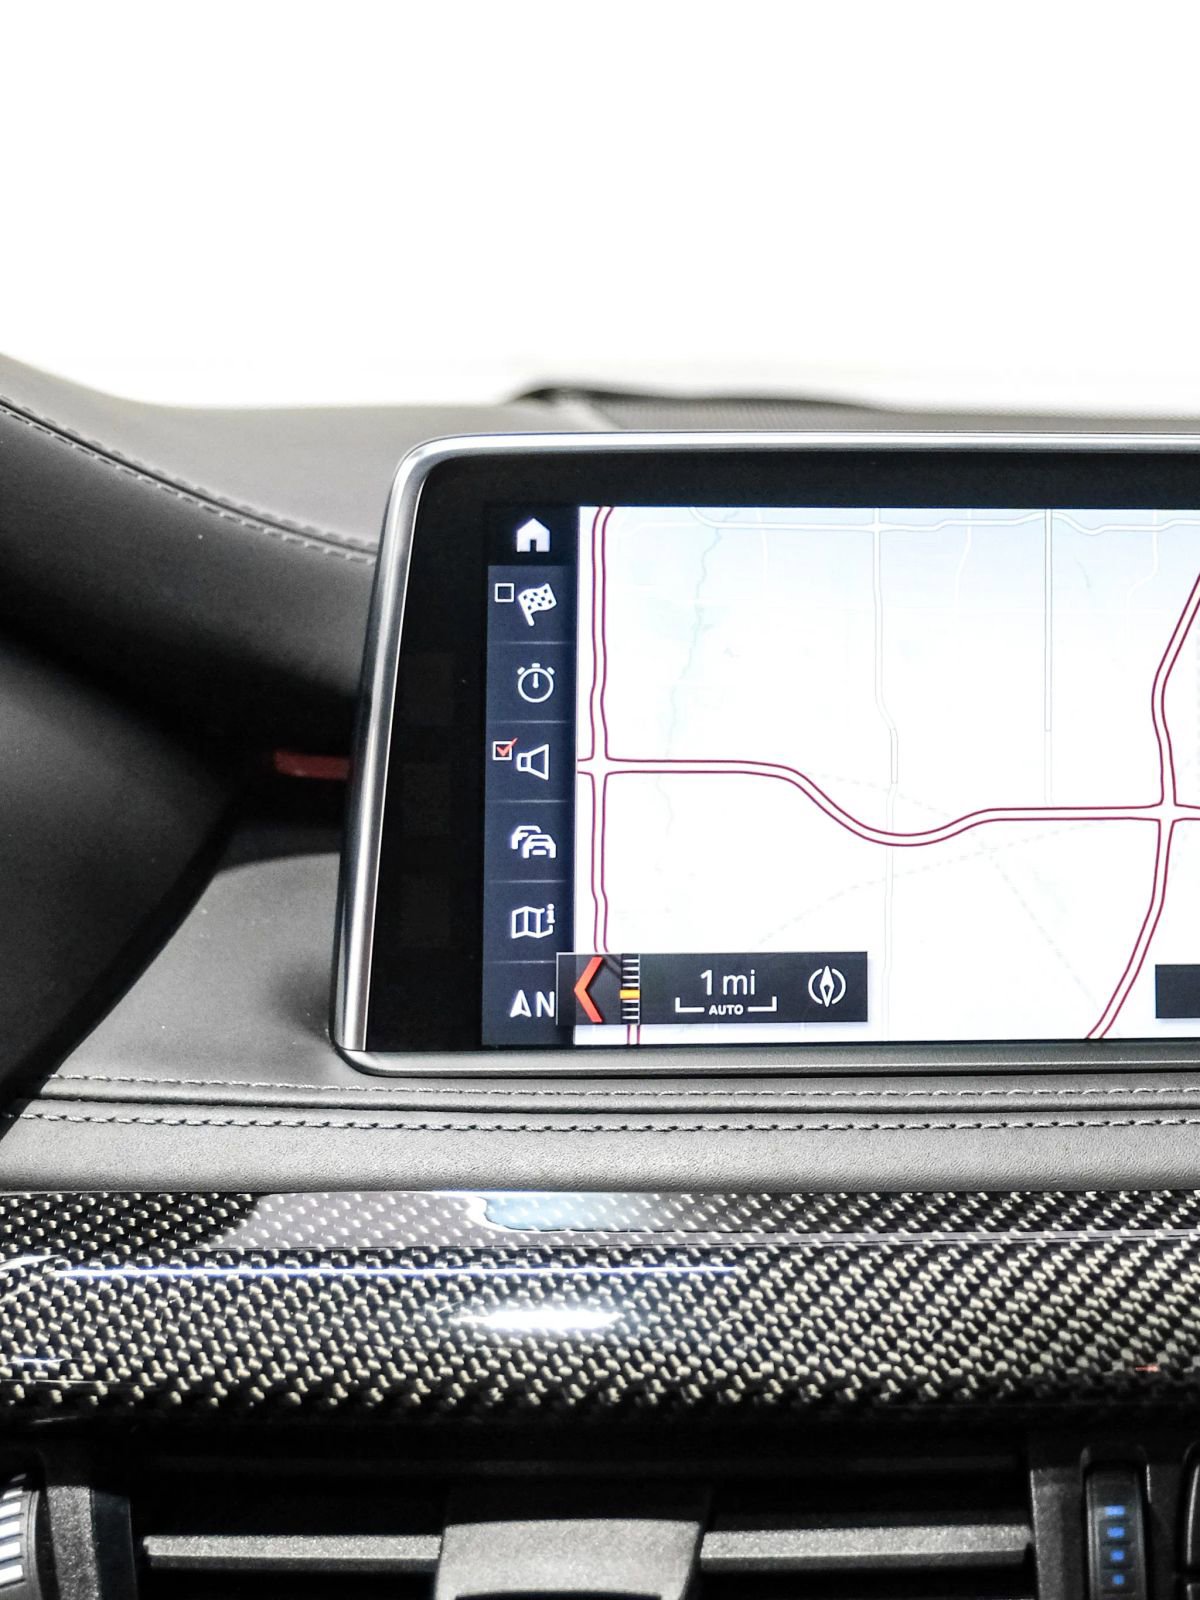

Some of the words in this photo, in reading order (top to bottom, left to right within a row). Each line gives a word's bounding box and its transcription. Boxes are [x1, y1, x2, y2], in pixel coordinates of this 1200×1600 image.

[699, 968, 713, 996] 1
[721, 968, 757, 996] mi
[708, 1003, 744, 1016] AUTO
